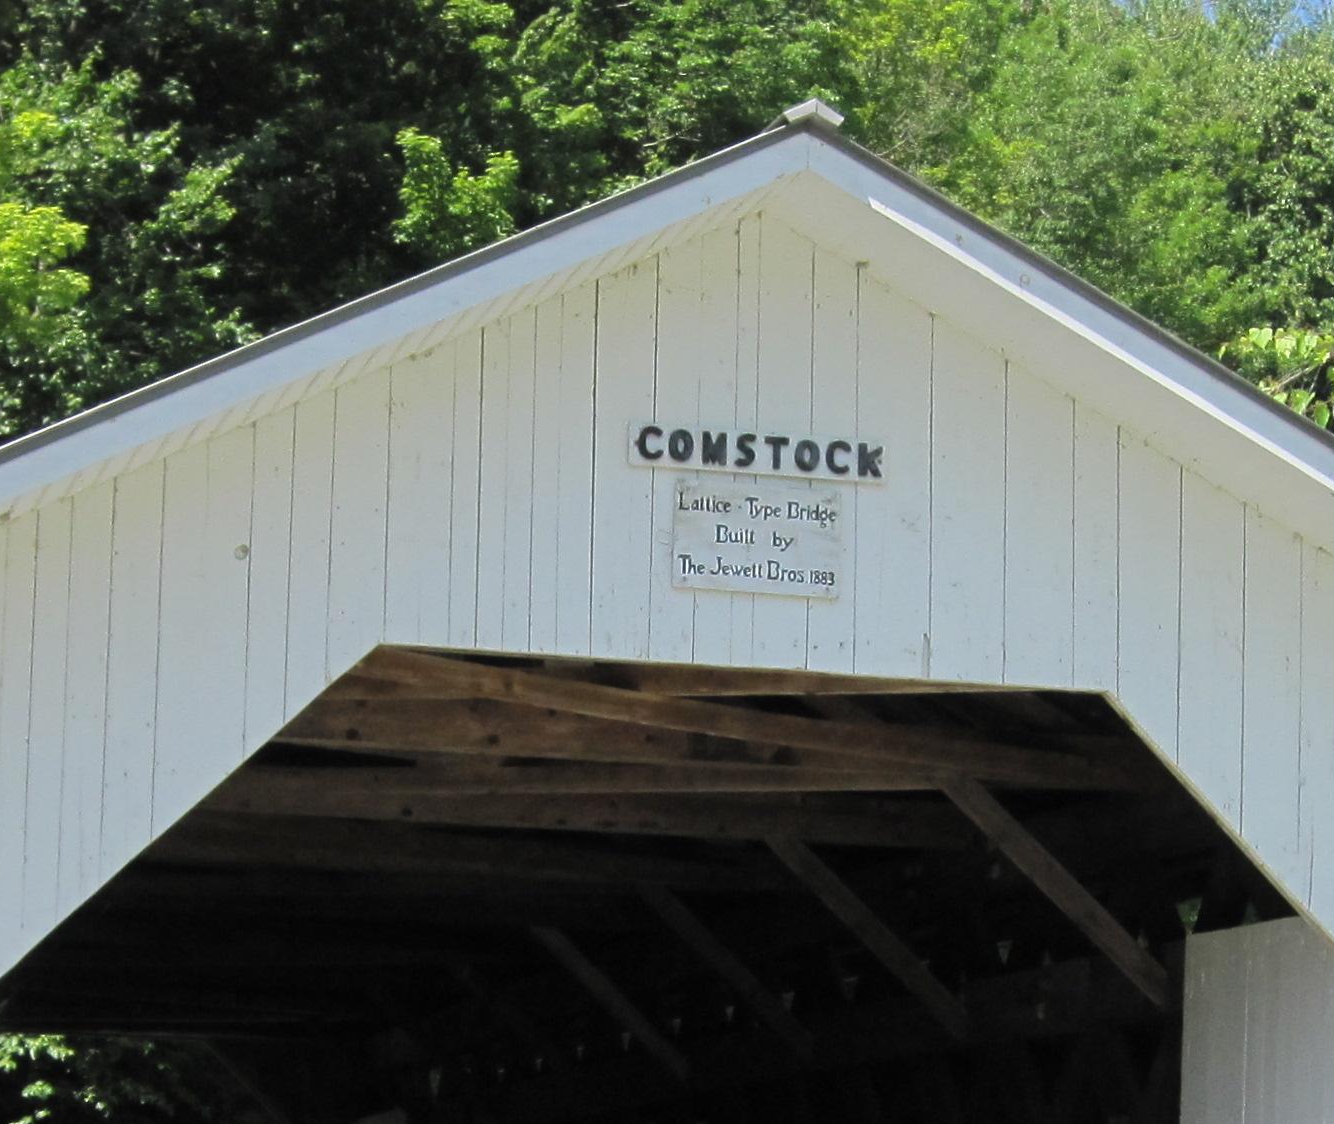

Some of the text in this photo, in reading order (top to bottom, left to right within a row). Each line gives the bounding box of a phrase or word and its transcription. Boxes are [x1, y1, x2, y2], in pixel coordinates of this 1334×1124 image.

[637, 425, 884, 478] COMSTOCK
[678, 491, 836, 528] Lattice Type Bridge
[715, 524, 794, 552] Built by
[677, 554, 705, 574] The
[710, 556, 762, 578] Jewett
[808, 570, 836, 586] 1883
